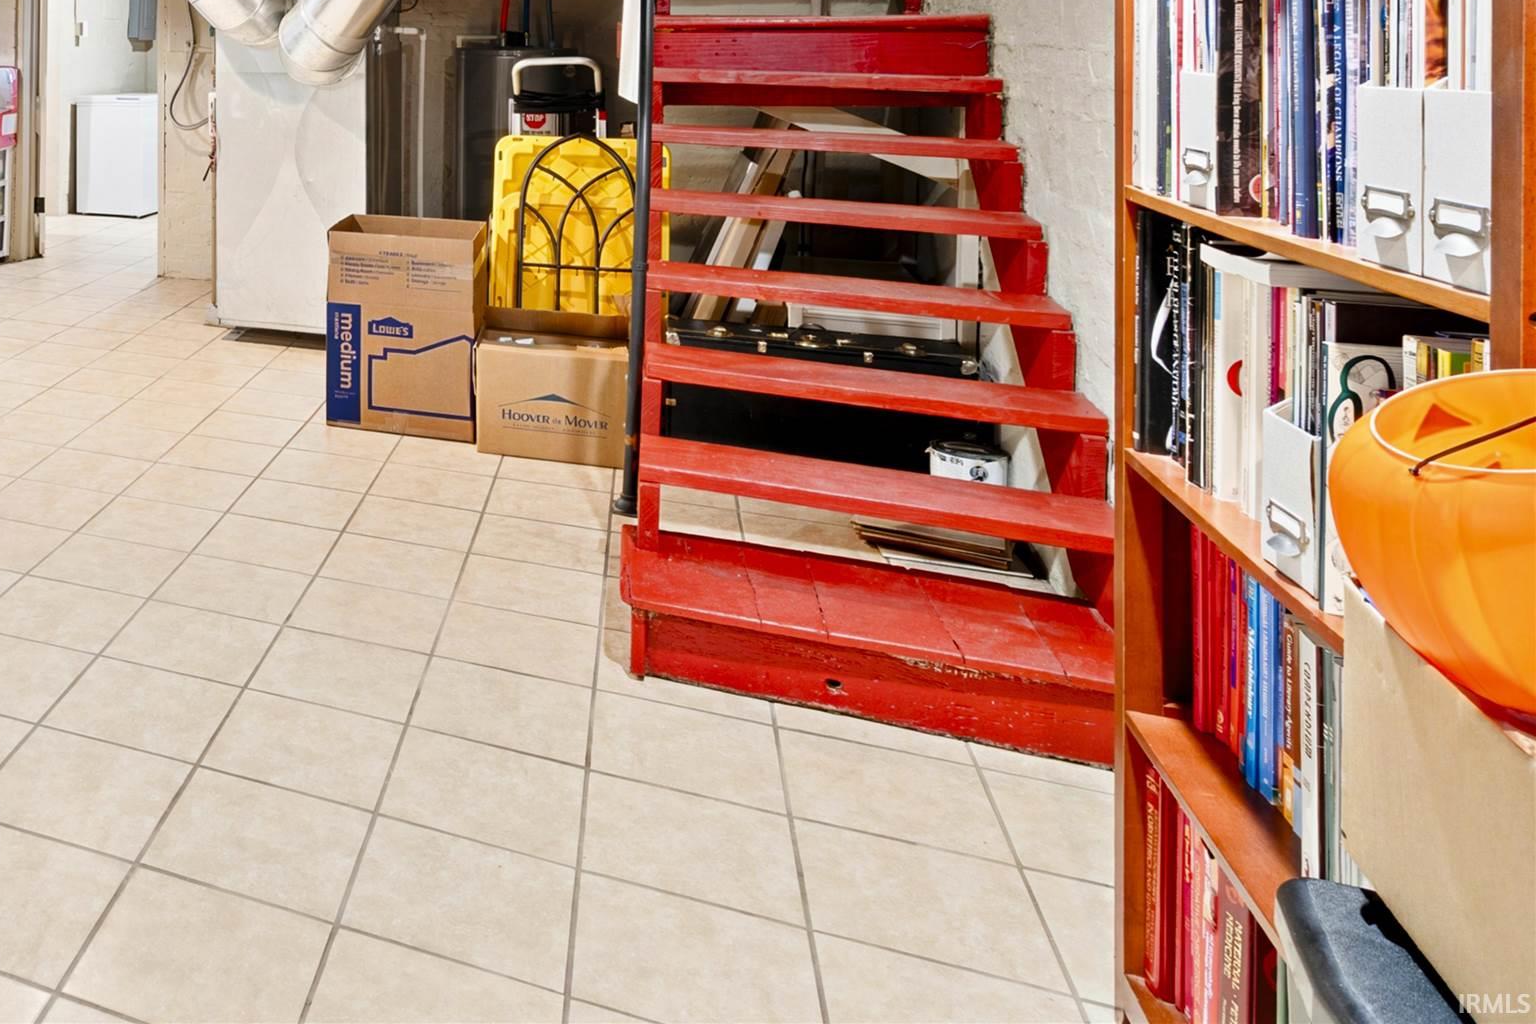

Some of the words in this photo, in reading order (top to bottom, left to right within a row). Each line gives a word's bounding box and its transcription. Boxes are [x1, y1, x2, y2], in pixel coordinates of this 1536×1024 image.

[525, 113, 545, 122] STOP
[1334, 108, 1342, 182] CHAMPIONS
[372, 323, 409, 336] LOWE'S
[340, 312, 357, 389] medium
[501, 408, 550, 425] HOOVER
[565, 415, 608, 431] MOVER
[1285, 633, 1294, 664] Guide
[1285, 665, 1293, 675] to
[1285, 676, 1294, 715] Literary
[1303, 662, 1312, 760] COMPENDIUM
[1285, 716, 1294, 749] Agents
[1223, 911, 1234, 979] MEDICINE
[1231, 920, 1243, 990] MATERNAL
